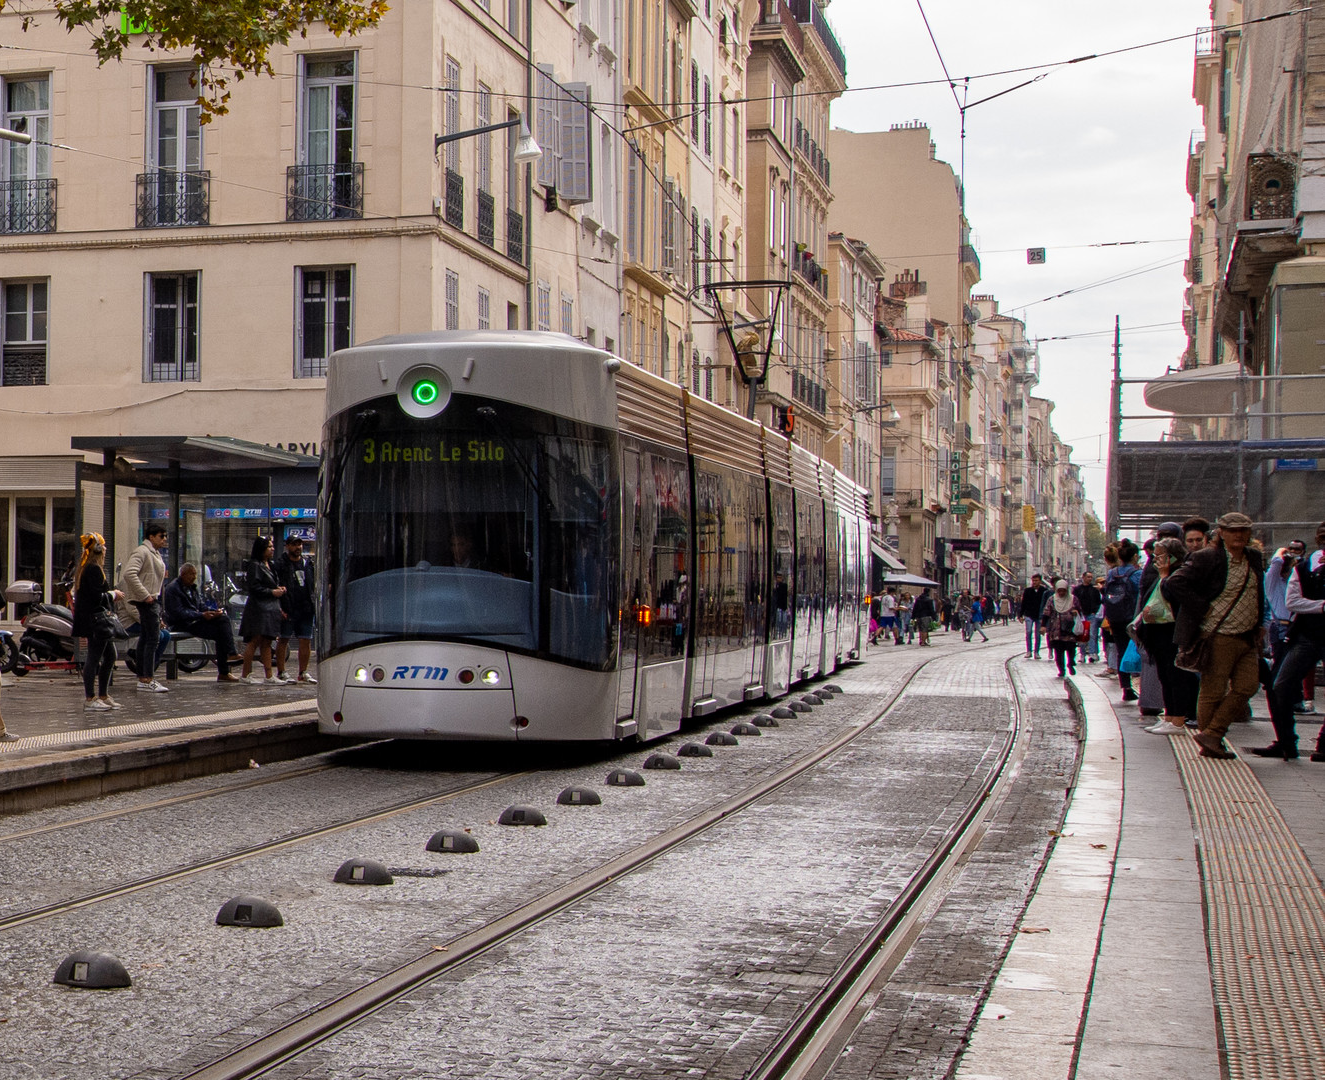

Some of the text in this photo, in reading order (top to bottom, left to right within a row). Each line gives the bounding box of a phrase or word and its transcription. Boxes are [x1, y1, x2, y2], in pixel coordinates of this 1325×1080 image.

[363, 438, 505, 463] 3 Arenc Le Silo
[392, 665, 449, 681] RTM
